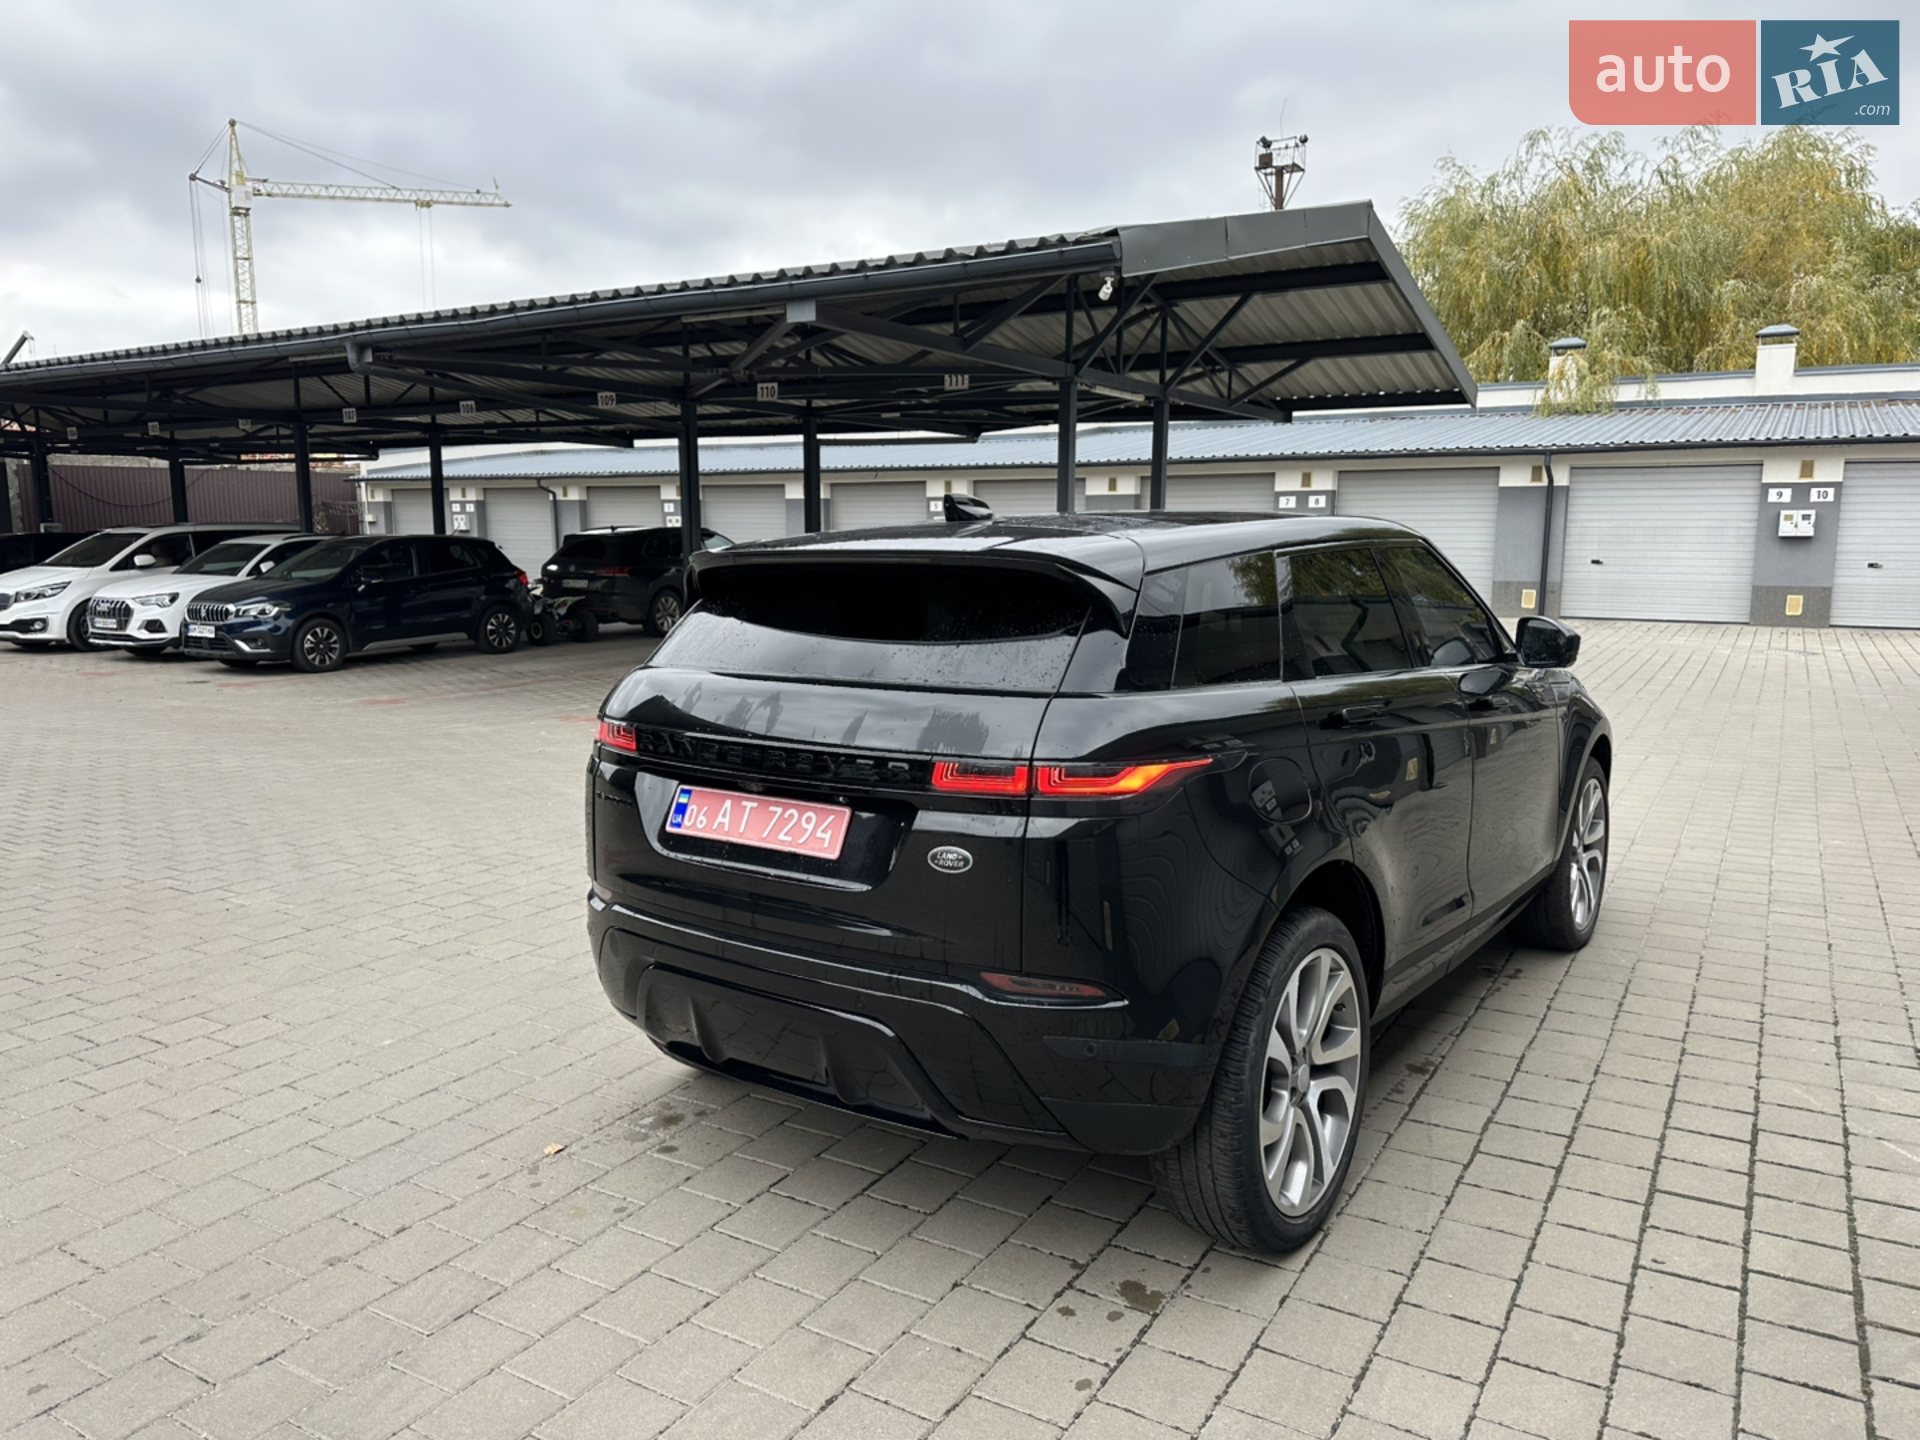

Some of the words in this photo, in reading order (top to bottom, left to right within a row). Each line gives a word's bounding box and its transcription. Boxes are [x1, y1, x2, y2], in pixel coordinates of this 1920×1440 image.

[759, 385, 776, 398] 110
[599, 394, 615, 407] 109
[1776, 490, 1784, 500] 9
[1816, 490, 1829, 500] 10
[1284, 498, 1290, 506] 7
[1313, 497, 1320, 506] 8
[684, 804, 709, 830] 06
[712, 799, 758, 834] AT
[761, 806, 836, 849] 7294
[936, 852, 958, 861] LAND
[938, 860, 965, 868] ROVER
